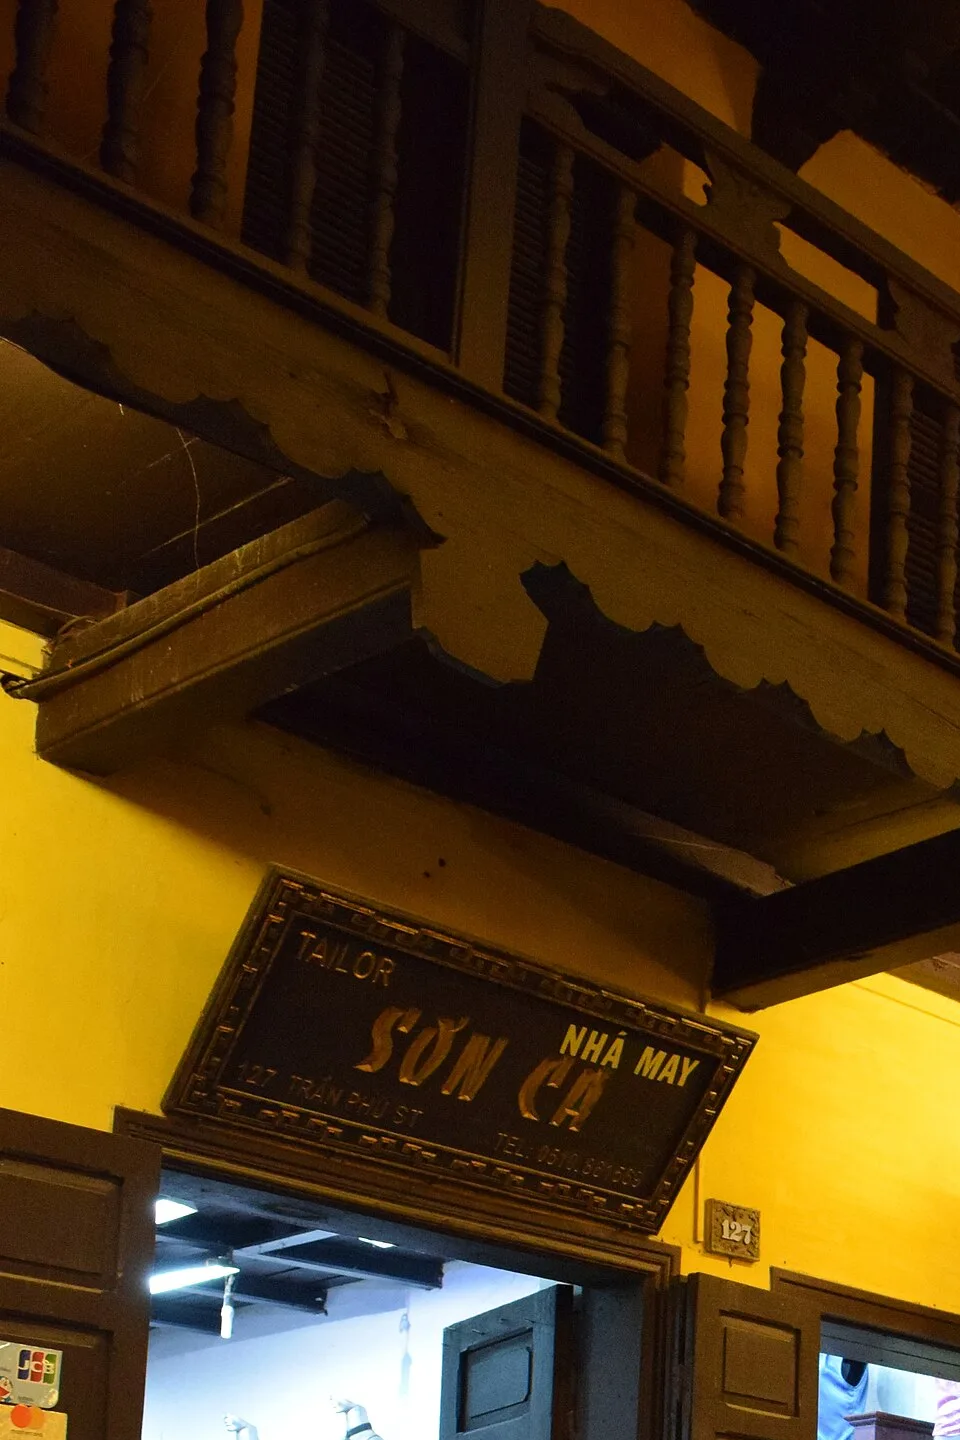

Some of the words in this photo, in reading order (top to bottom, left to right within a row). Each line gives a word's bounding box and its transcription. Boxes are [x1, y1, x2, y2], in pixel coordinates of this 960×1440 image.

[297, 929, 397, 988] TAILOR
[237, 1062, 279, 1088] 127
[392, 1104, 426, 1128] ST
[517, 1054, 614, 1132] CA
[633, 1045, 700, 1087] MAY
[721, 1219, 753, 1245] 127
